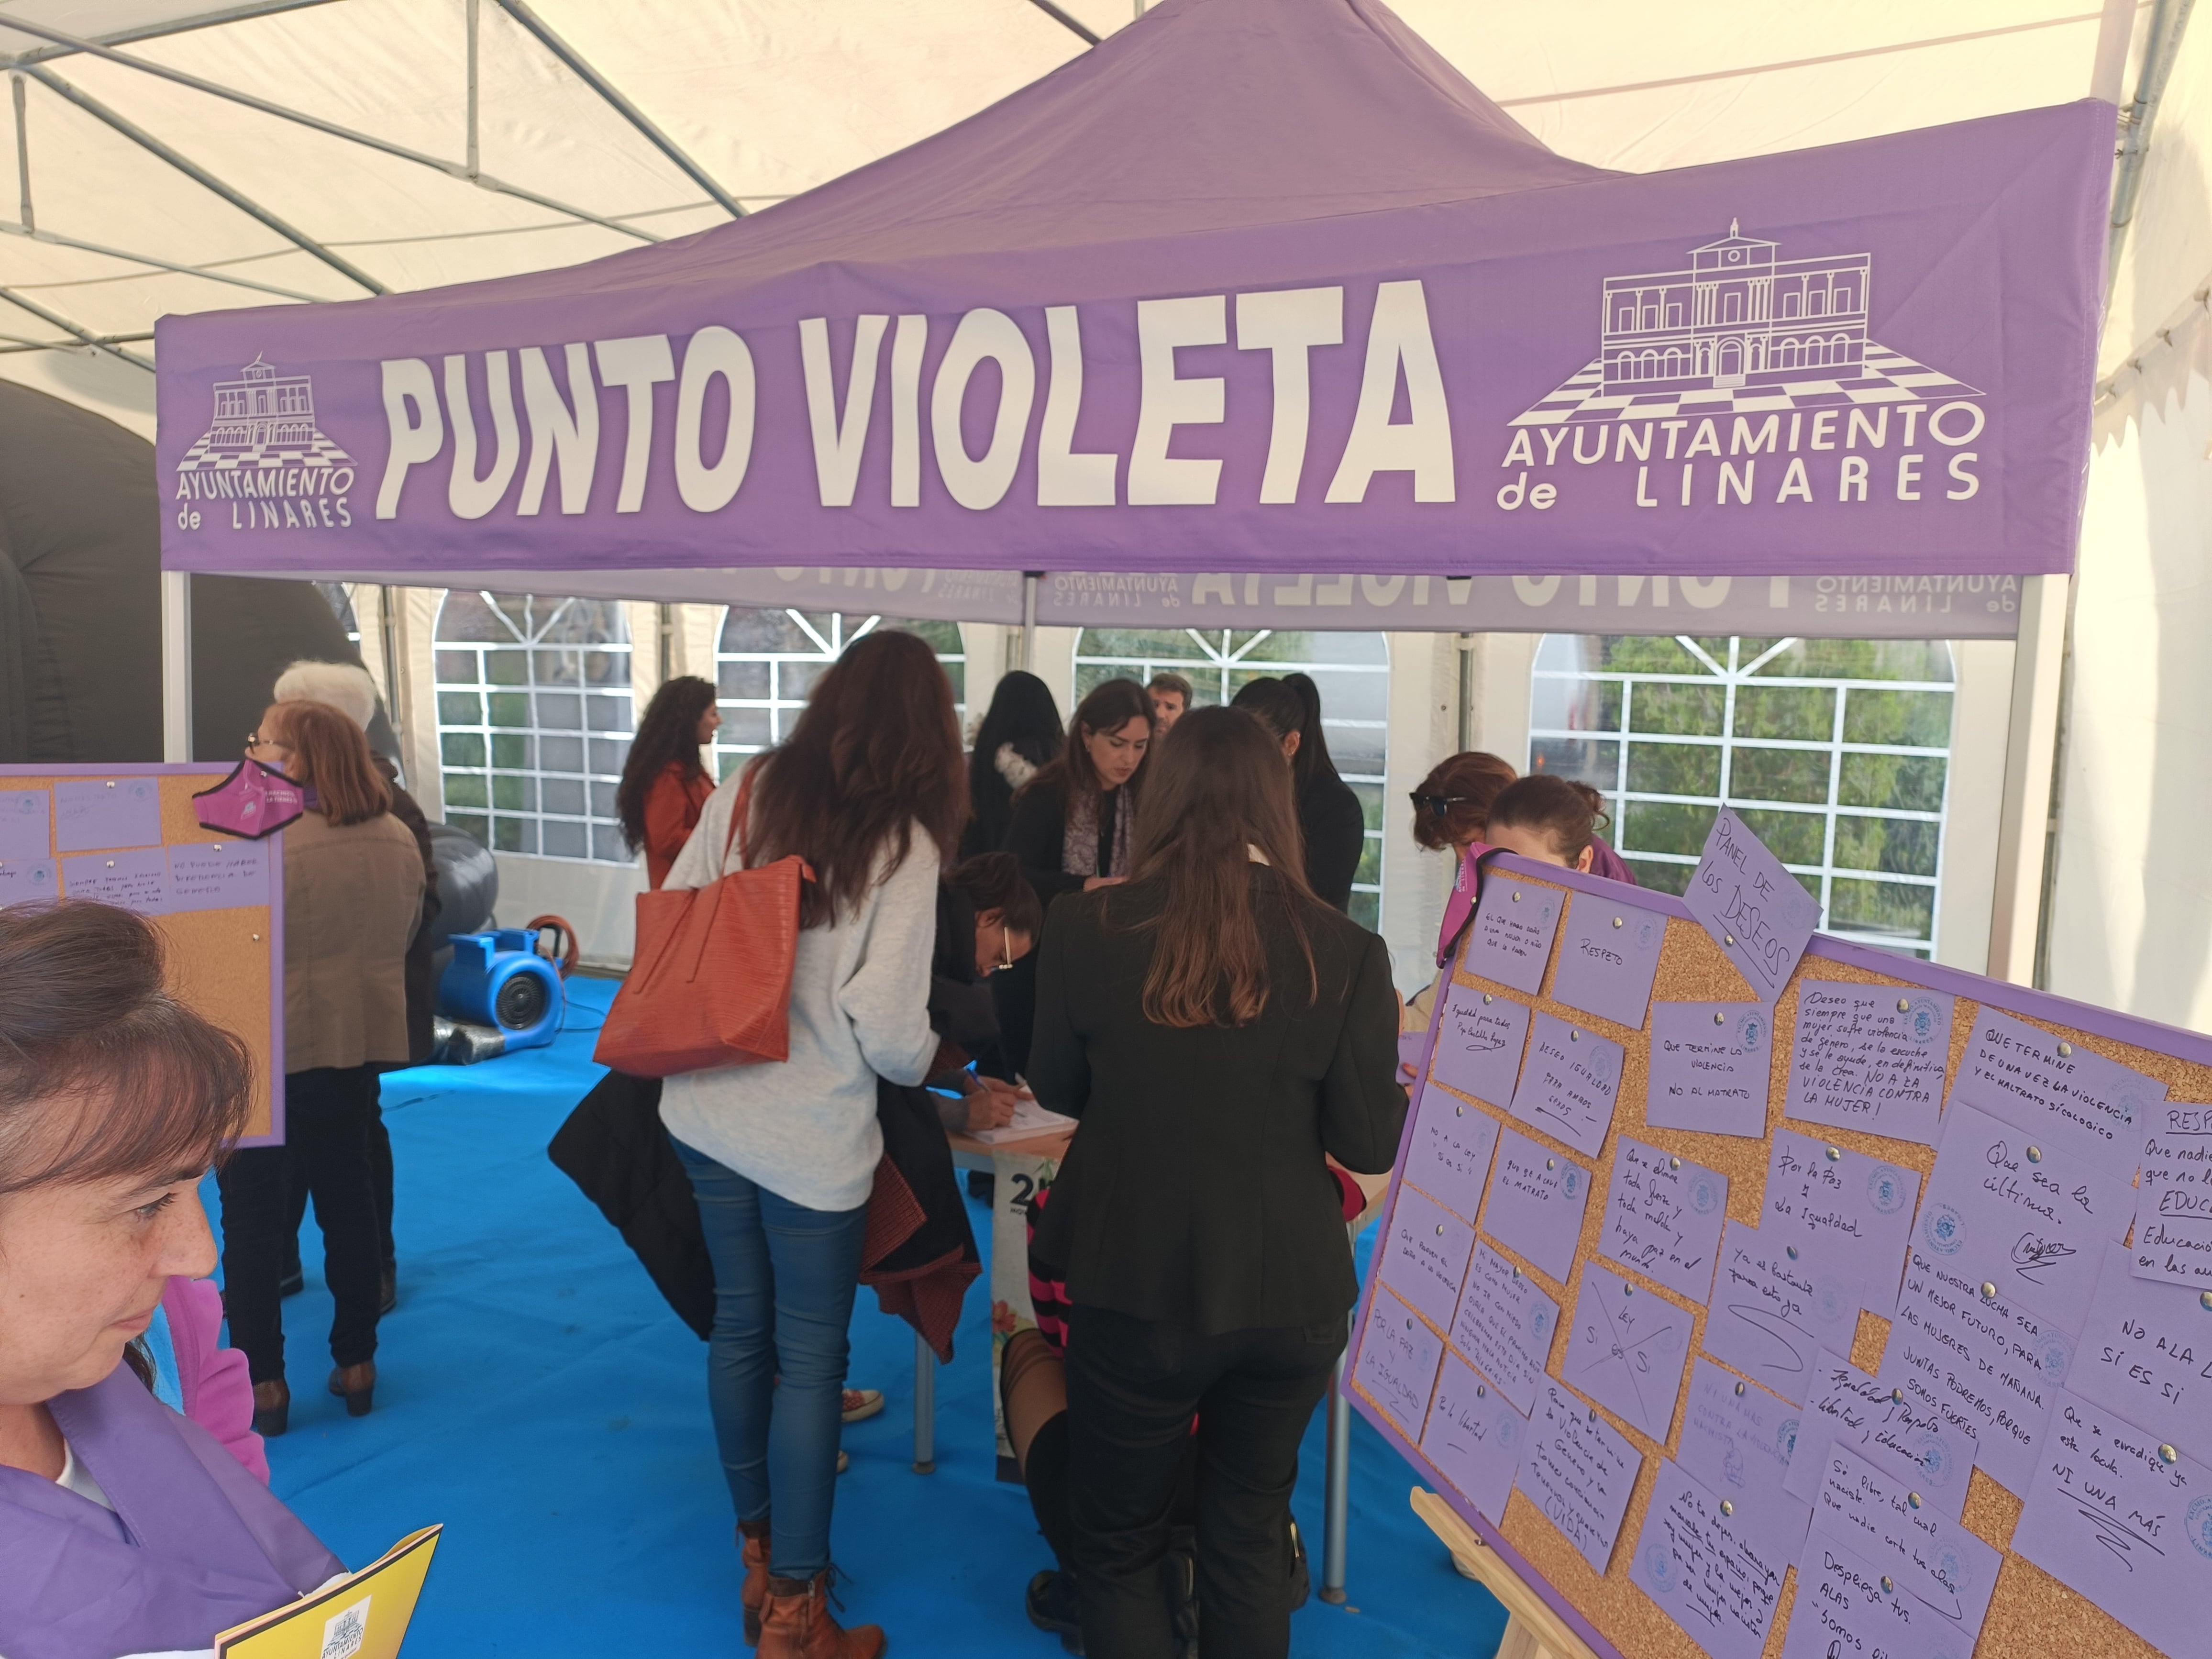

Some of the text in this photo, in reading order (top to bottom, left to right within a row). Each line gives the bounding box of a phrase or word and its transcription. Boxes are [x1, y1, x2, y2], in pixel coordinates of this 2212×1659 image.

[376, 279, 1456, 520] PUNTO VIOLETA
[1501, 401, 1985, 468] AYUNTAMIENTO
[176, 467, 354, 499] AYUNTAMIENTO
[1496, 452, 1979, 510] de LINARES
[177, 497, 352, 530] de LINARES
[1716, 818, 1775, 902] PANEL DE
[1720, 885, 1790, 975] DESEOS
[1581, 938, 1623, 965] RESPETO
[1804, 992, 1875, 1011] Deseo que
[1803, 1020, 1908, 1041] mujer sufre violencia
[1805, 1007, 1846, 1022] siempre
[1853, 1013, 1872, 1027] que
[1664, 1040, 1680, 1051] QUE
[1685, 1043, 1726, 1054] TERMINE
[1800, 1048, 1807, 1058] y
[1825, 1048, 1832, 1060] le
[1876, 1059, 1888, 1068] en
[1801, 1031, 1928, 1058] de se la escuche
[1986, 1029, 2076, 1073] QUE TERMINE
[1539, 1041, 1564, 1061] DESEO
[1570, 1062, 1611, 1095] IGUALDAD
[1800, 1062, 1810, 1070] se
[1816, 1059, 1823, 1072] la
[1865, 1069, 1883, 1084] NO
[1888, 1074, 1898, 1085] A
[1567, 1090, 1592, 1109] AMBOS
[1669, 1083, 1683, 1096] NO
[1691, 1087, 1703, 1095] AL
[1803, 1075, 1929, 1103] VIOLENCIA CONTRA
[1804, 1092, 1817, 1104] LA
[1998, 1078, 2045, 1106] MALTRATO
[2145, 1138, 2171, 1157] Que
[1779, 1145, 1802, 1176] Por
[1807, 1161, 1818, 1179] la
[1515, 1181, 1548, 1200] MATRATO
[2032, 1172, 2060, 1195] sea
[1802, 1208, 1862, 1237] Igualdad
[1913, 1254, 2038, 1336] QUE NUESTRA SEA
[1908, 1279, 1924, 1294] UN
[1928, 1290, 1956, 1316] MEJOR
[2013, 1343, 2042, 1371] PARA
[1901, 1305, 1919, 1326] LAS
[1924, 1322, 1970, 1361] MUJERES
[1979, 1359, 1993, 1375] DE
[1903, 1347, 1940, 1379] JUNTAS
[2129, 1364, 2153, 1385] ES
[1907, 1378, 1977, 1439] SOMOS FUERTES
[2052, 1463, 2073, 1484] NI
[2085, 1482, 2116, 1510] UNA
[1820, 1582, 1848, 1610] ALAS
[322, 1627, 363, 1659] AYUNTAMIENTO
